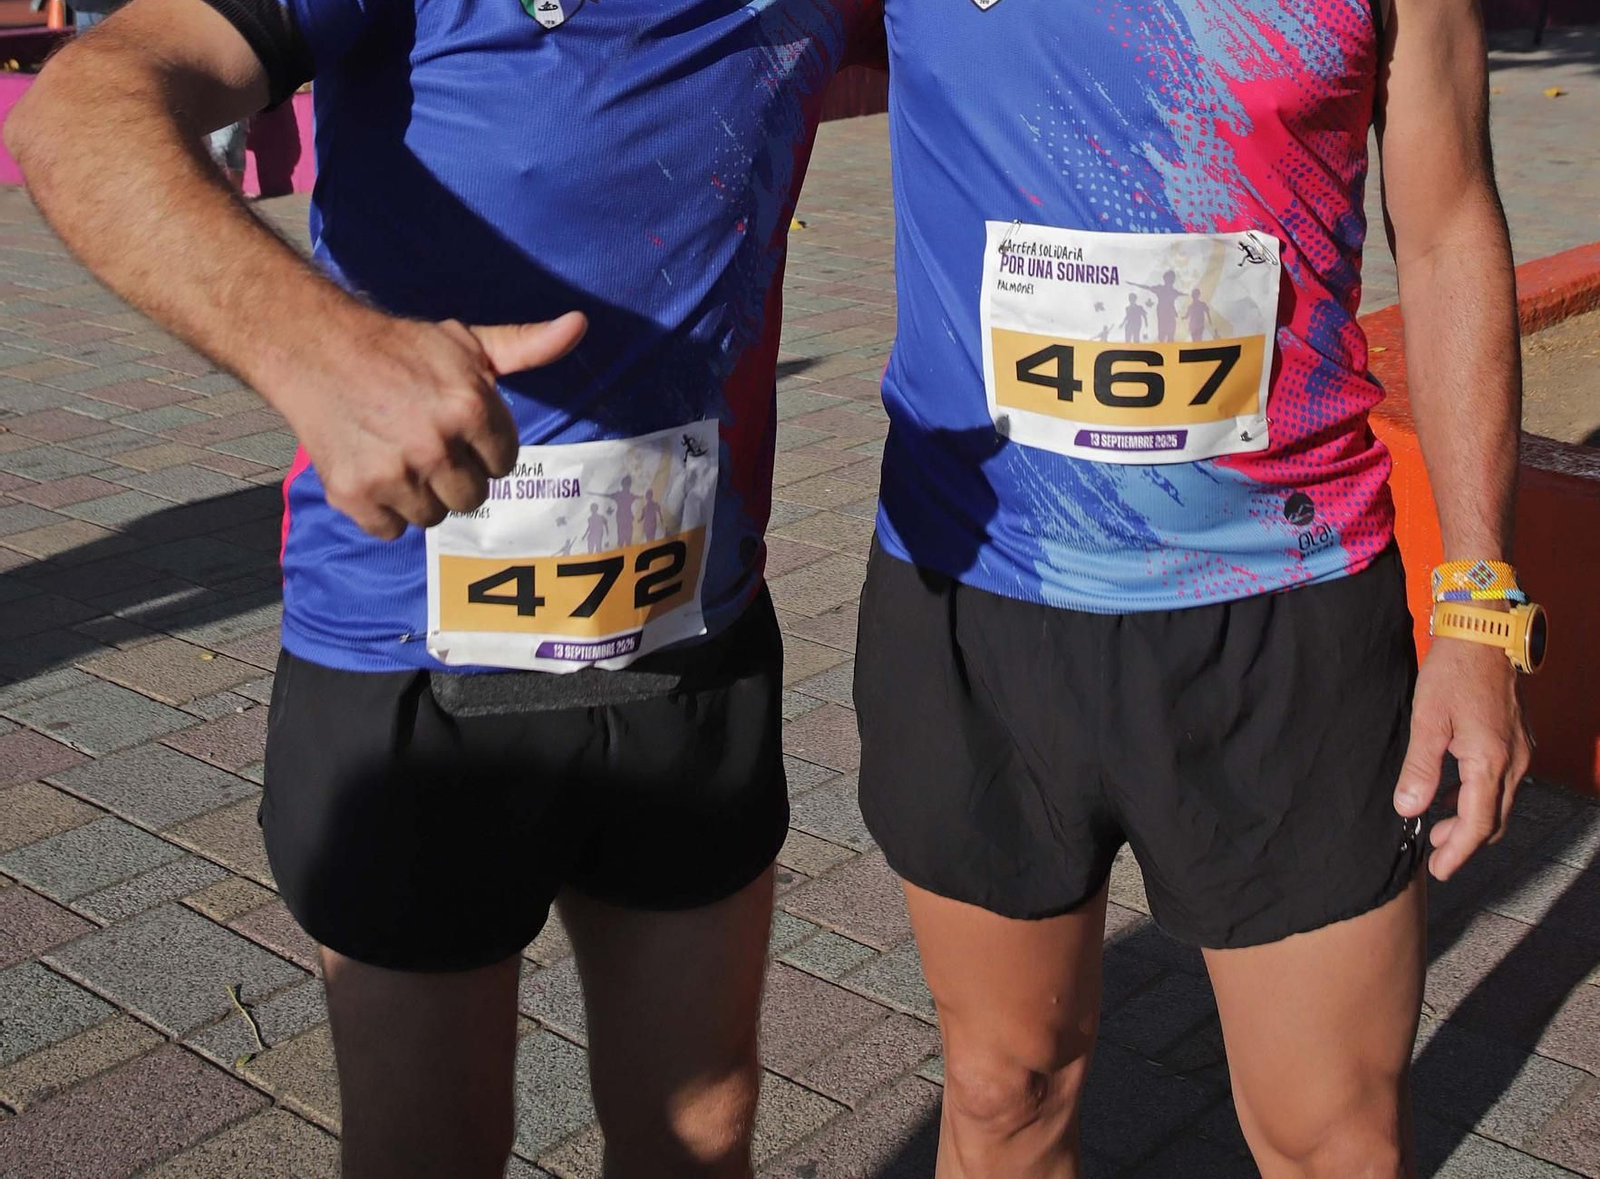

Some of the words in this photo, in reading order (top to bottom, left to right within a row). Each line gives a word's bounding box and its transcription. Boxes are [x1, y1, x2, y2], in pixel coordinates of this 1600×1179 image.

[1000, 254, 1024, 275] POR
[1028, 258, 1053, 279] UNA
[1057, 262, 1119, 285] SONRISA
[1015, 344, 1242, 408] 467
[1090, 432, 1100, 447] 13
[1101, 434, 1154, 449] SEPTIEMBRE
[516, 478, 581, 499] SONRISA
[467, 540, 686, 618] 472
[554, 644, 564, 658] 13
[565, 642, 615, 660] SEPTIEMBRE
